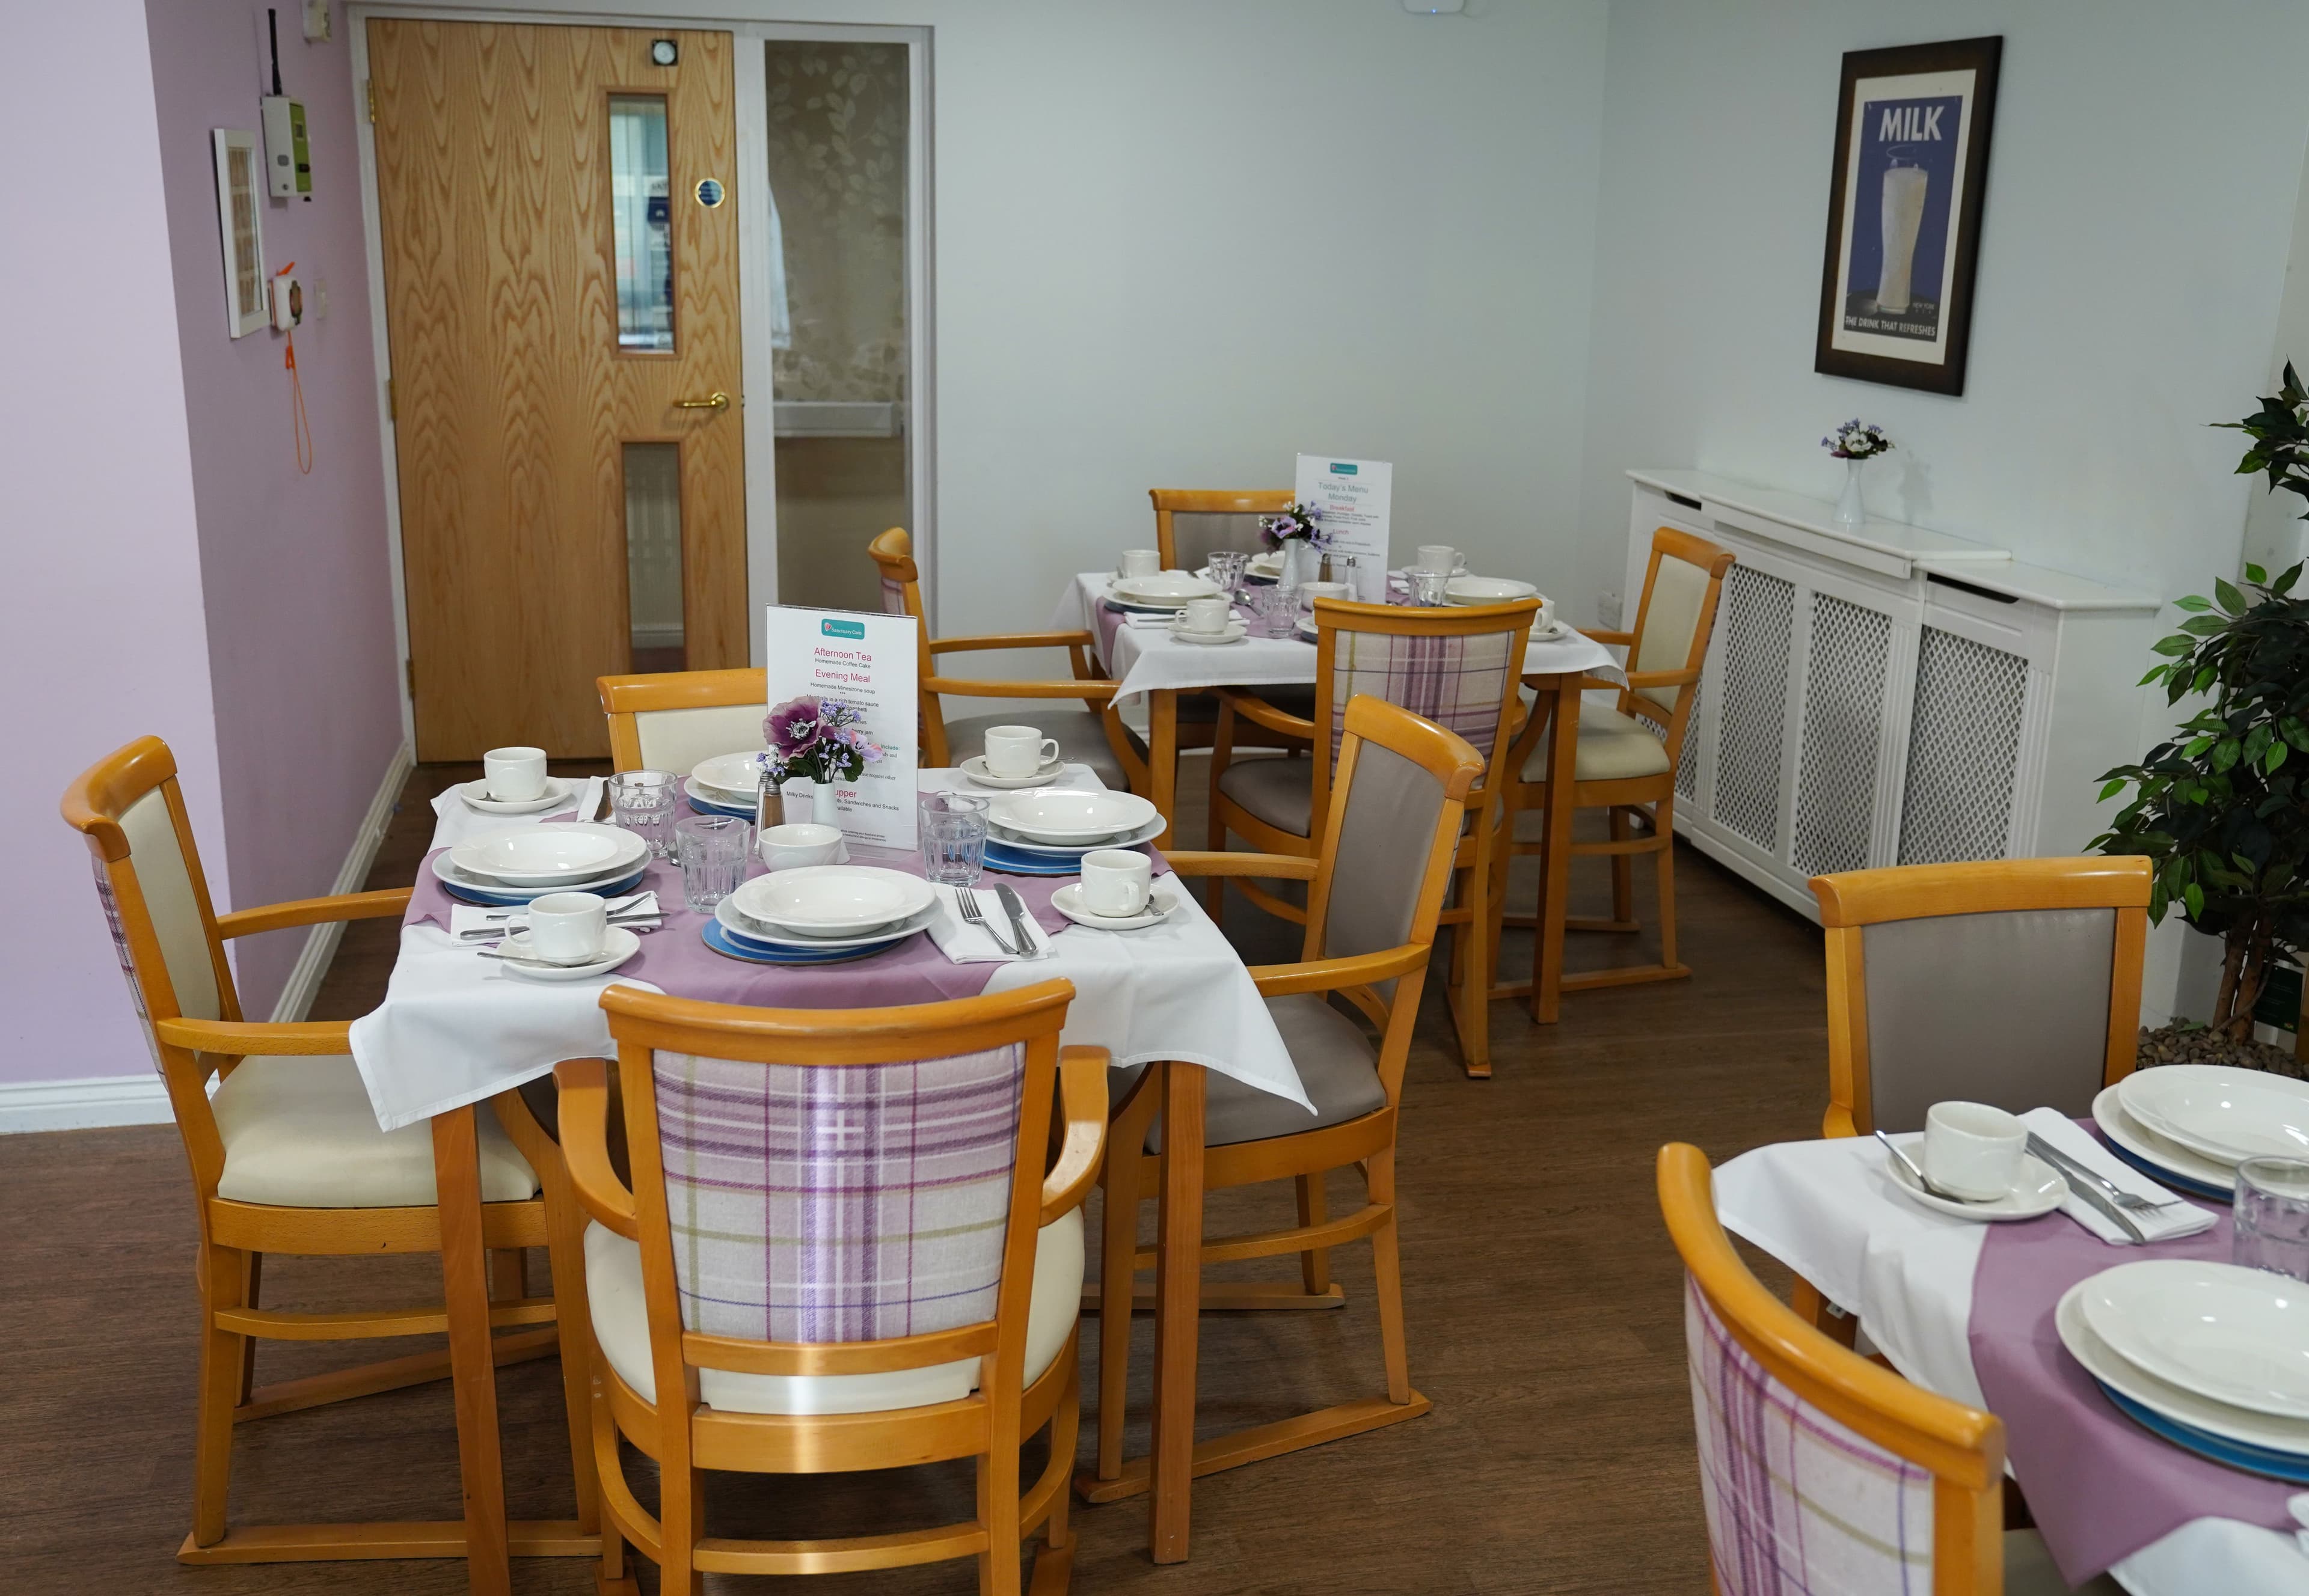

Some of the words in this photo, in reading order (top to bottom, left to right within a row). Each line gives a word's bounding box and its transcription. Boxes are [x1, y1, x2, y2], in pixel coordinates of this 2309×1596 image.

[1878, 105, 1945, 142] MILK
[1845, 316, 1857, 326] THE
[1859, 317, 1879, 329] DRINK
[1881, 320, 1898, 331] THAT
[1899, 322, 1935, 337] REFRESHES
[1318, 482, 1346, 492] Today's
[1348, 485, 1369, 494] Menu
[1328, 493, 1357, 504] Monday
[831, 626, 852, 635] Sanctuary
[814, 647, 853, 659] Afternoon
[856, 652, 871, 661] Tea
[815, 668, 848, 682] Evening
[851, 673, 871, 683] Meal
[844, 798, 871, 807] Sandwiches
